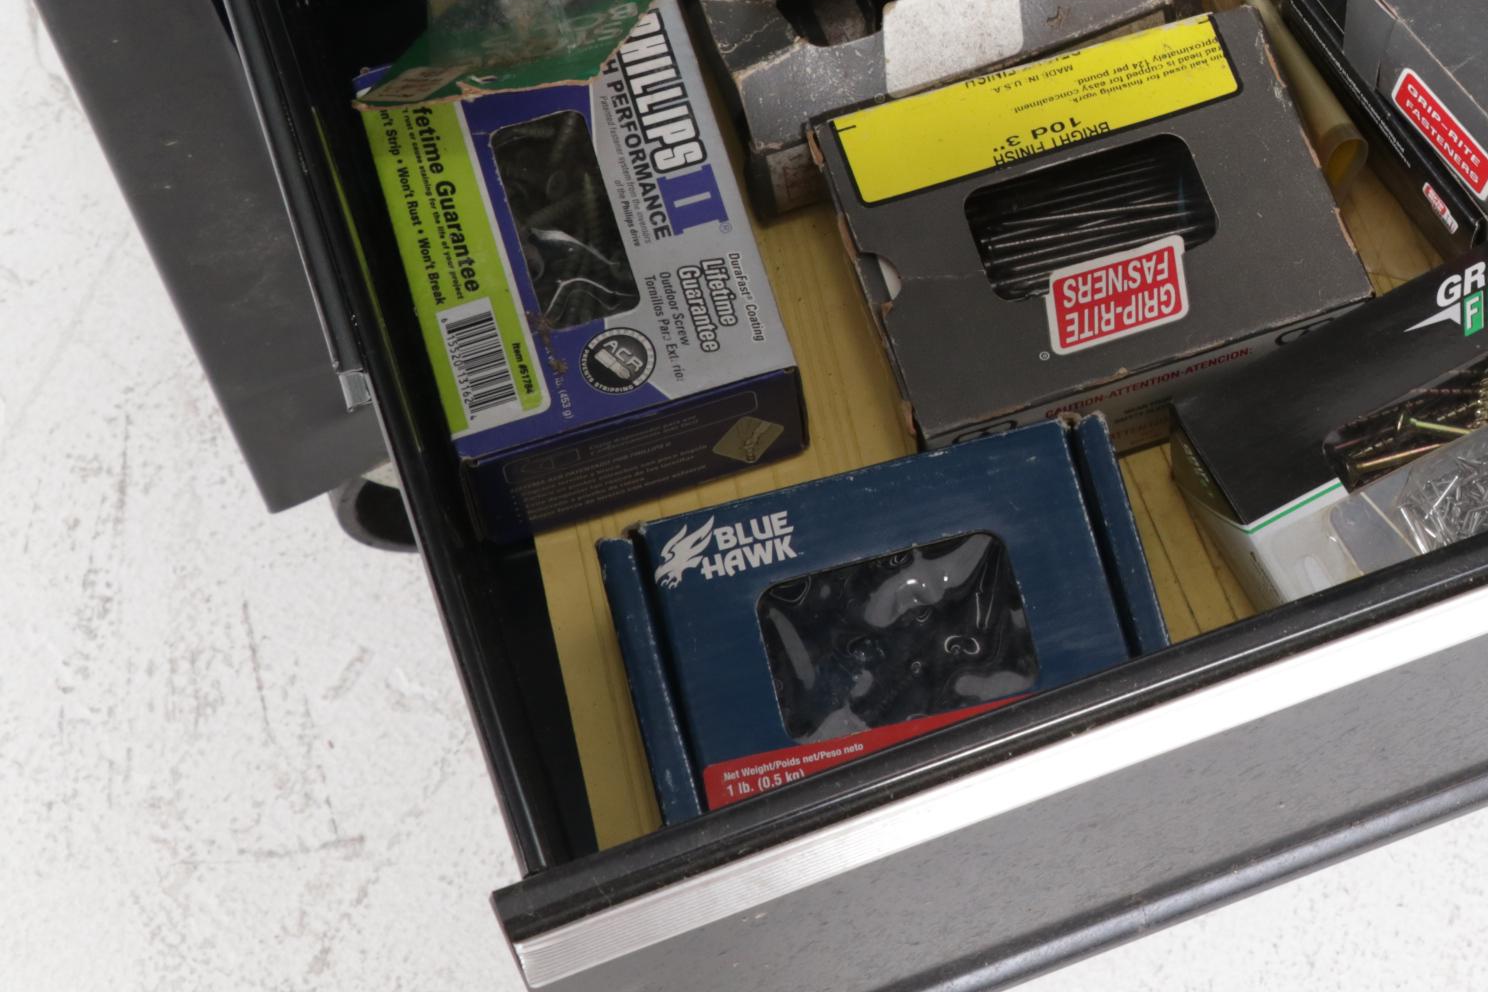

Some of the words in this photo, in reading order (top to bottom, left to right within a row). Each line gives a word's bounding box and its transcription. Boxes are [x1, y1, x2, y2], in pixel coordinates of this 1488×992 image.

[620, 7, 706, 178] PHILLIPS
[1030, 114, 1081, 140] 10d
[1047, 119, 1110, 148] BRIGHT
[1403, 99, 1480, 183] FASTENERS
[1405, 83, 1482, 167] GRIP-RITE
[605, 79, 672, 241] PERFORMANCE
[991, 139, 1045, 165] FINISH
[383, 128, 403, 156] Strip
[395, 166, 415, 198] Won't
[406, 201, 423, 227] Rust
[416, 237, 436, 270] Won't
[426, 270, 447, 306] Break
[411, 104, 450, 176] fetime
[433, 178, 485, 293] Guarantee
[643, 274, 666, 317] Tornillos
[699, 255, 742, 329] Lifetime
[1058, 250, 1173, 308] FAS'NERS
[658, 270, 680, 310] Outdoor
[671, 311, 690, 346] Screw
[675, 262, 722, 354] Guarantee
[744, 302, 765, 342] Coating
[1060, 281, 1179, 343] GRIP-RITE
[511, 341, 524, 363] Item
[601, 336, 644, 373] ACR
[517, 362, 534, 394] #51784
[712, 509, 795, 551] BLUE
[697, 534, 798, 583] HAWK
[723, 769, 739, 781] Net
[741, 756, 800, 777] Weight/Poids
[802, 747, 841, 764] net/Peso
[843, 742, 864, 754] neto
[727, 785, 734, 796] 1
[738, 781, 754, 793] lb.
[757, 772, 782, 792] (0.5
